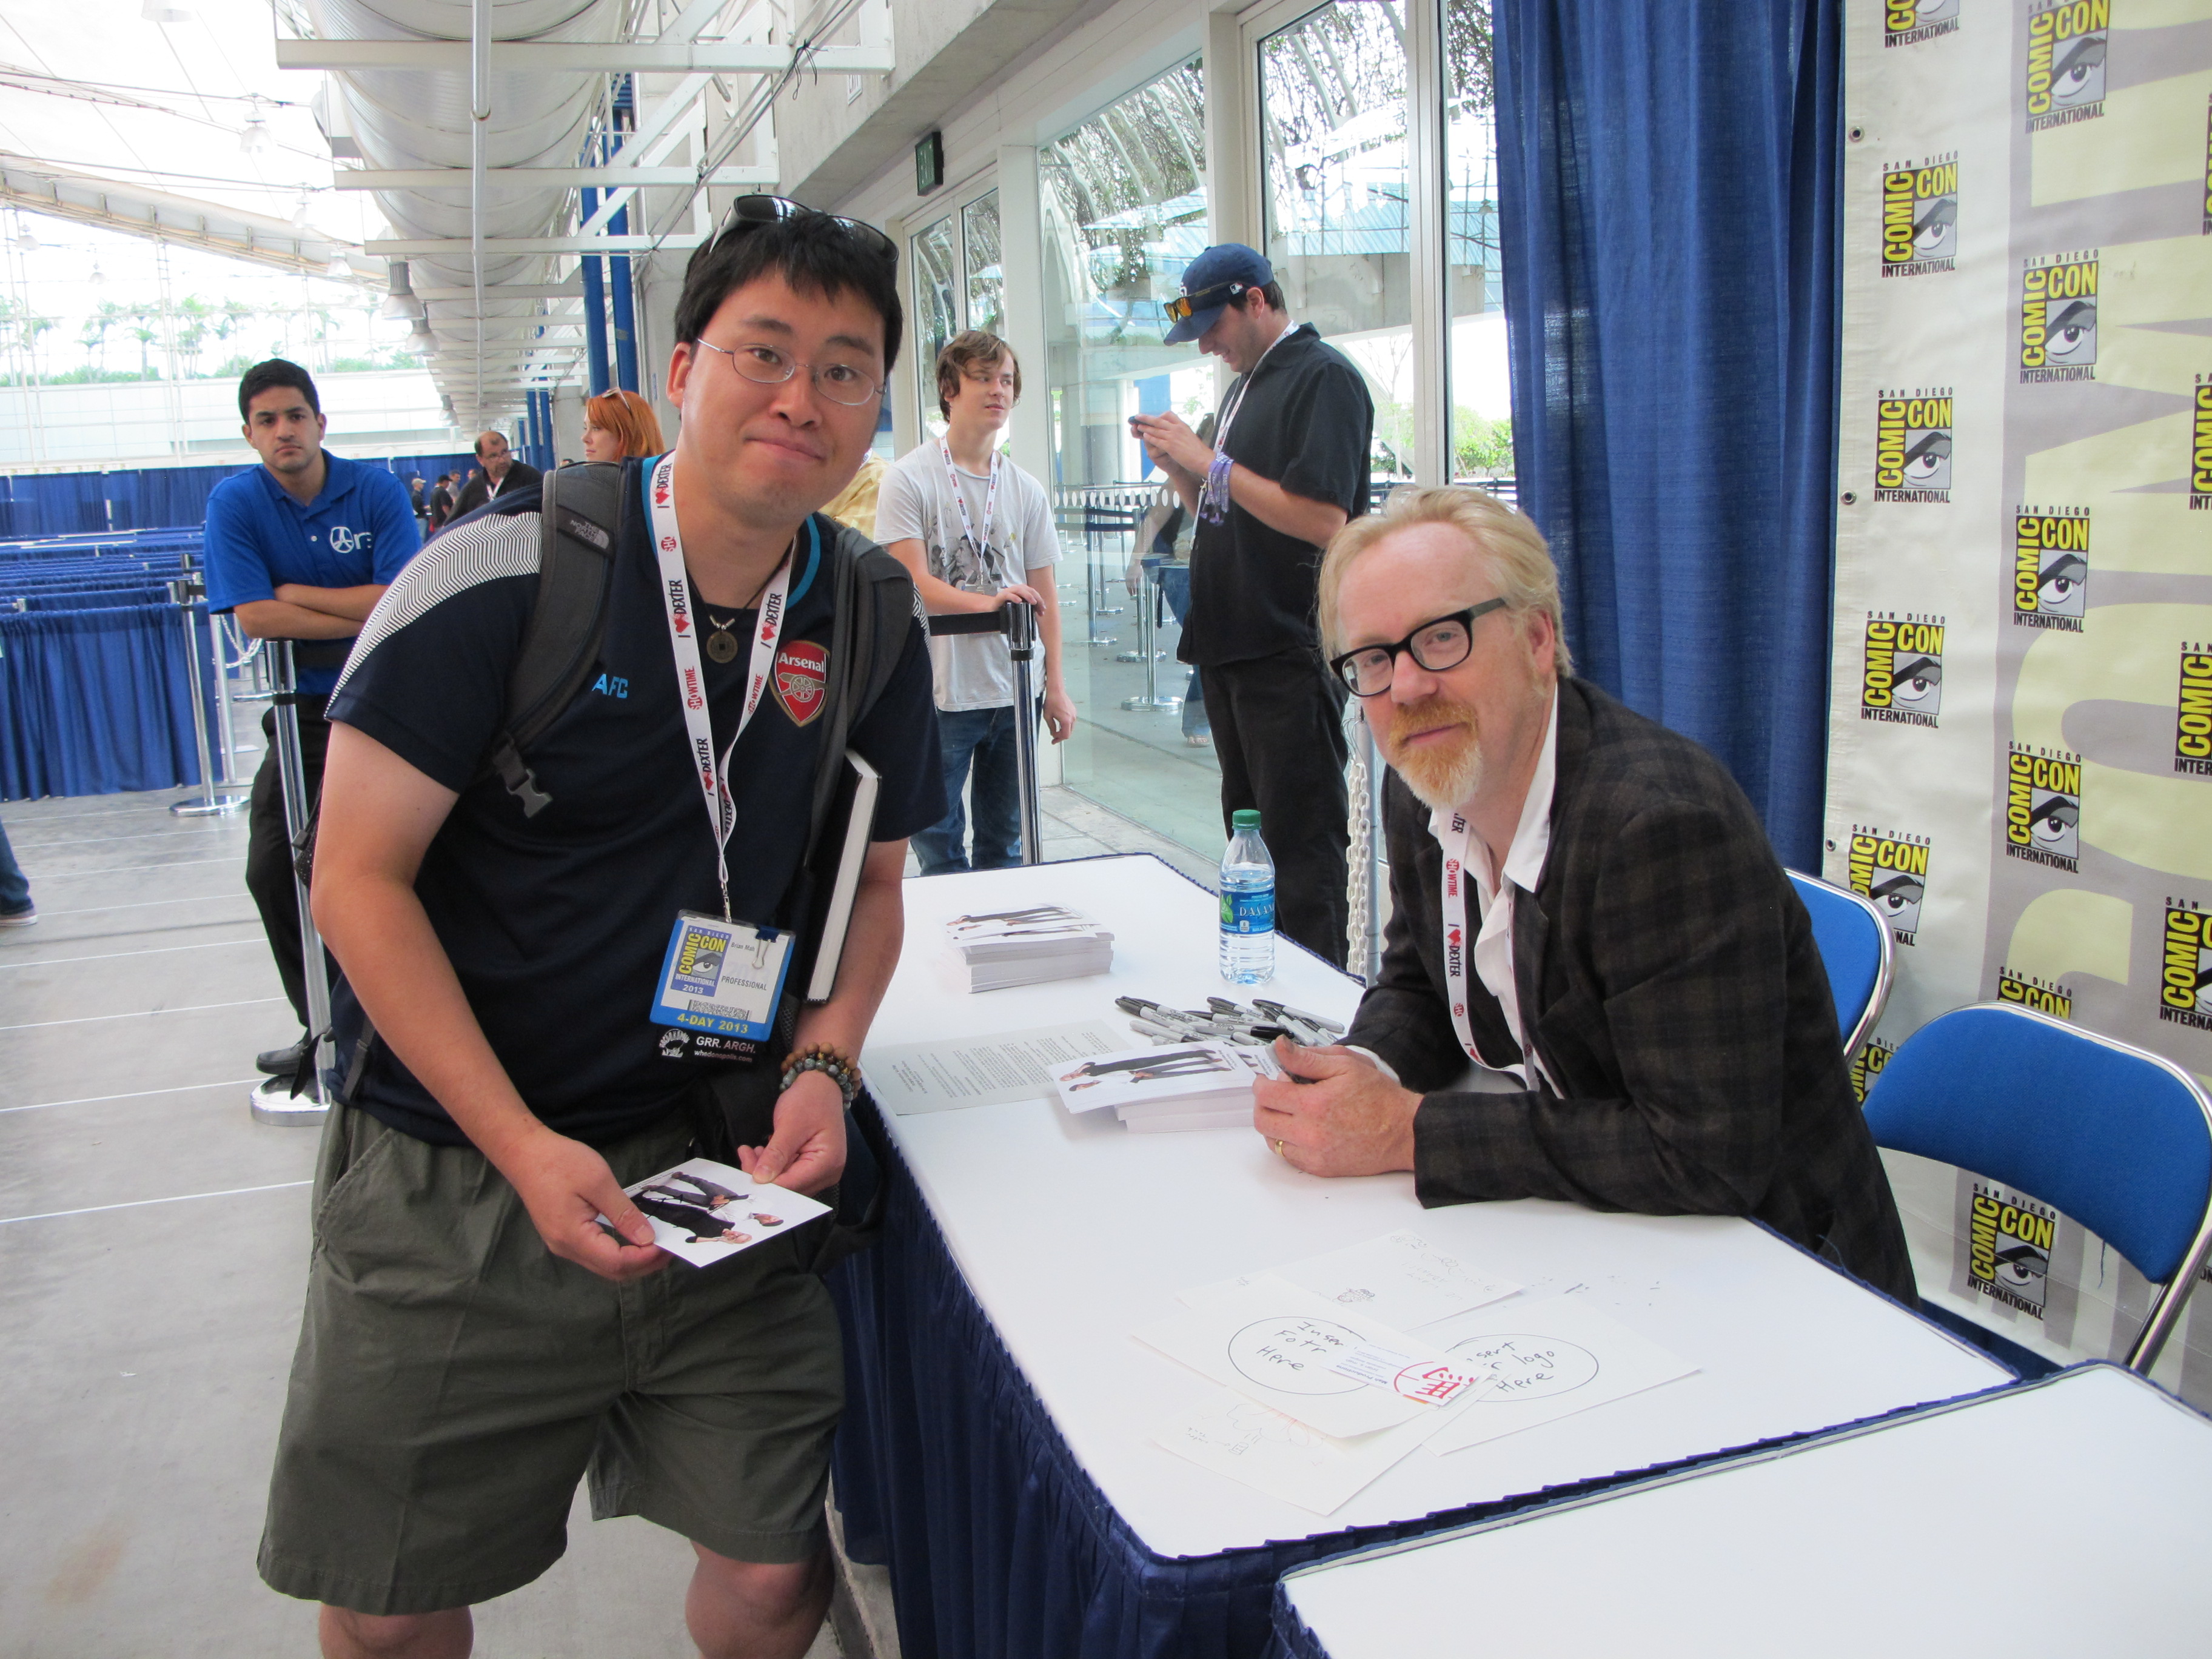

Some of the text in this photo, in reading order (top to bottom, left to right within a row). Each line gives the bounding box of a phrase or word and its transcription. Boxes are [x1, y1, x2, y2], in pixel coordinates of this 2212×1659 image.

[1885, 17, 1960, 48] INTERNATIONAL
[2056, 0, 2110, 39] CON
[2028, 12, 2054, 114] COMIC
[2025, 102, 2104, 134] INTERNATIONAL
[1883, 150, 1958, 172] SAN DIEGO
[1916, 163, 1957, 199] CON
[1884, 172, 1914, 261] COMIC
[1882, 258, 1955, 278] INTERNATIONAL
[2023, 249, 2099, 268] SAN DIEGO
[2048, 262, 2097, 299] CON
[2022, 269, 2047, 366] COMIC
[2020, 366, 2096, 384] INTERNATIONAL
[1879, 387, 1952, 398] SAN DIEGO
[1908, 398, 1951, 428] CON
[1877, 401, 1906, 488] COMIC
[657, 463, 672, 489] DEXTER
[1874, 489, 1951, 503] INTERNATIONAL
[2016, 505, 2090, 516] SAN DIEGO
[2042, 518, 2088, 551] CON
[2016, 517, 2040, 611] COMIC
[668, 580, 686, 615] DEXTER
[765, 593, 782, 626] DEXTER
[1867, 611, 1945, 625] SAN DIEGO
[2014, 612, 2084, 633] INTERNATIONAL
[1897, 623, 1943, 655] CON
[778, 652, 824, 672] Arsenal
[1864, 622, 1895, 706] COMIC
[592, 674, 629, 699] AFC
[1861, 708, 1939, 728] INTERNATIONAL
[2178, 655, 2212, 757] COMIC
[696, 738, 711, 773] DEXTER
[2008, 740, 2081, 762] SAN DIEGO
[2033, 759, 2080, 796] CON
[2008, 754, 2032, 845] COMIC
[1852, 824, 1931, 845] SAN DIEGO
[1877, 840, 1928, 874] CON
[2006, 843, 2079, 873] INTERNATIONAL
[1446, 858, 1460, 898] SHOWTIME
[2165, 896, 2198, 911] SAN
[679, 933, 701, 974] COMIC
[700, 936, 726, 952] CON
[1449, 945, 1463, 977] DEXTER
[2163, 911, 2200, 1008] COMIC
[675, 974, 716, 987] INTERNATIONAL
[682, 984, 704, 994] 2013
[721, 976, 767, 991] PROFESSIONAL
[2000, 967, 2022, 980] SAN
[2033, 977, 2072, 997] DIEGO
[677, 1013, 748, 1033] 4-DAY 2013
[696, 1036, 722, 1048] GRR.
[723, 1041, 756, 1053] ARGH.
[1974, 1183, 2055, 1219] SAN DIEGO
[1971, 1196, 2000, 1280] COMIC
[2001, 1206, 2053, 1250] CON
[1967, 1275, 2043, 1321] INTERNATIONAL
[1256, 1346, 1304, 1370] Here
[1511, 1351, 1555, 1368] logo
[1496, 1373, 1554, 1392] Here
